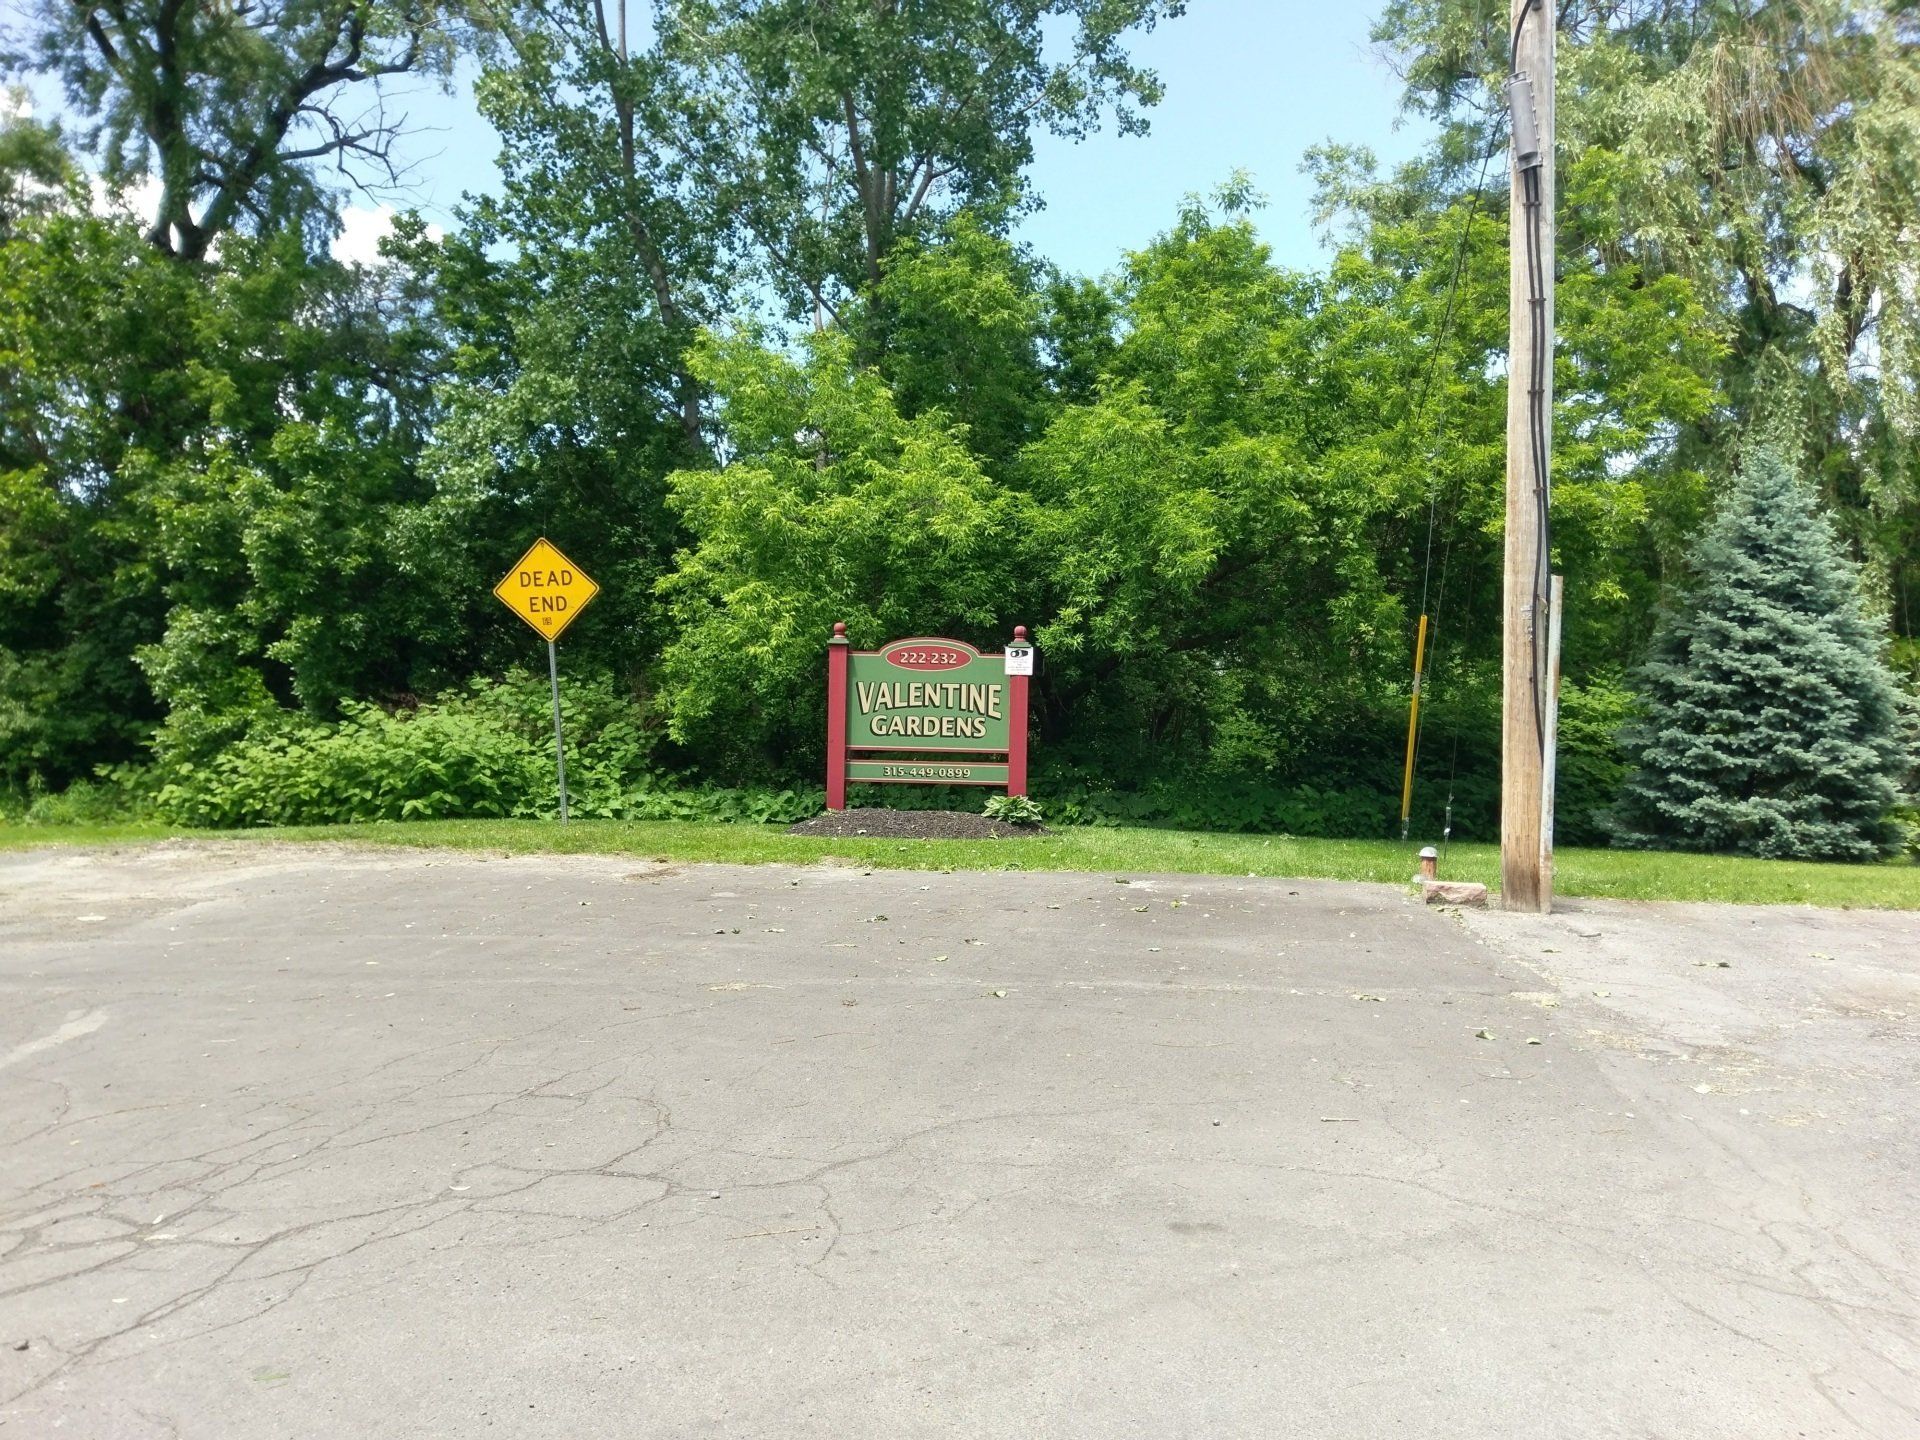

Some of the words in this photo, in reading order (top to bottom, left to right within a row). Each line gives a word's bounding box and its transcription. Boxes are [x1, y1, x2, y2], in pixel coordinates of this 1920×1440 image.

[520, 570, 573, 588] DEAD
[530, 595, 567, 613] END
[900, 652, 957, 665] 222-232
[857, 681, 1002, 719] VALENTINE
[871, 714, 987, 738] GARDENS
[883, 766, 971, 778] 315-449-0899
